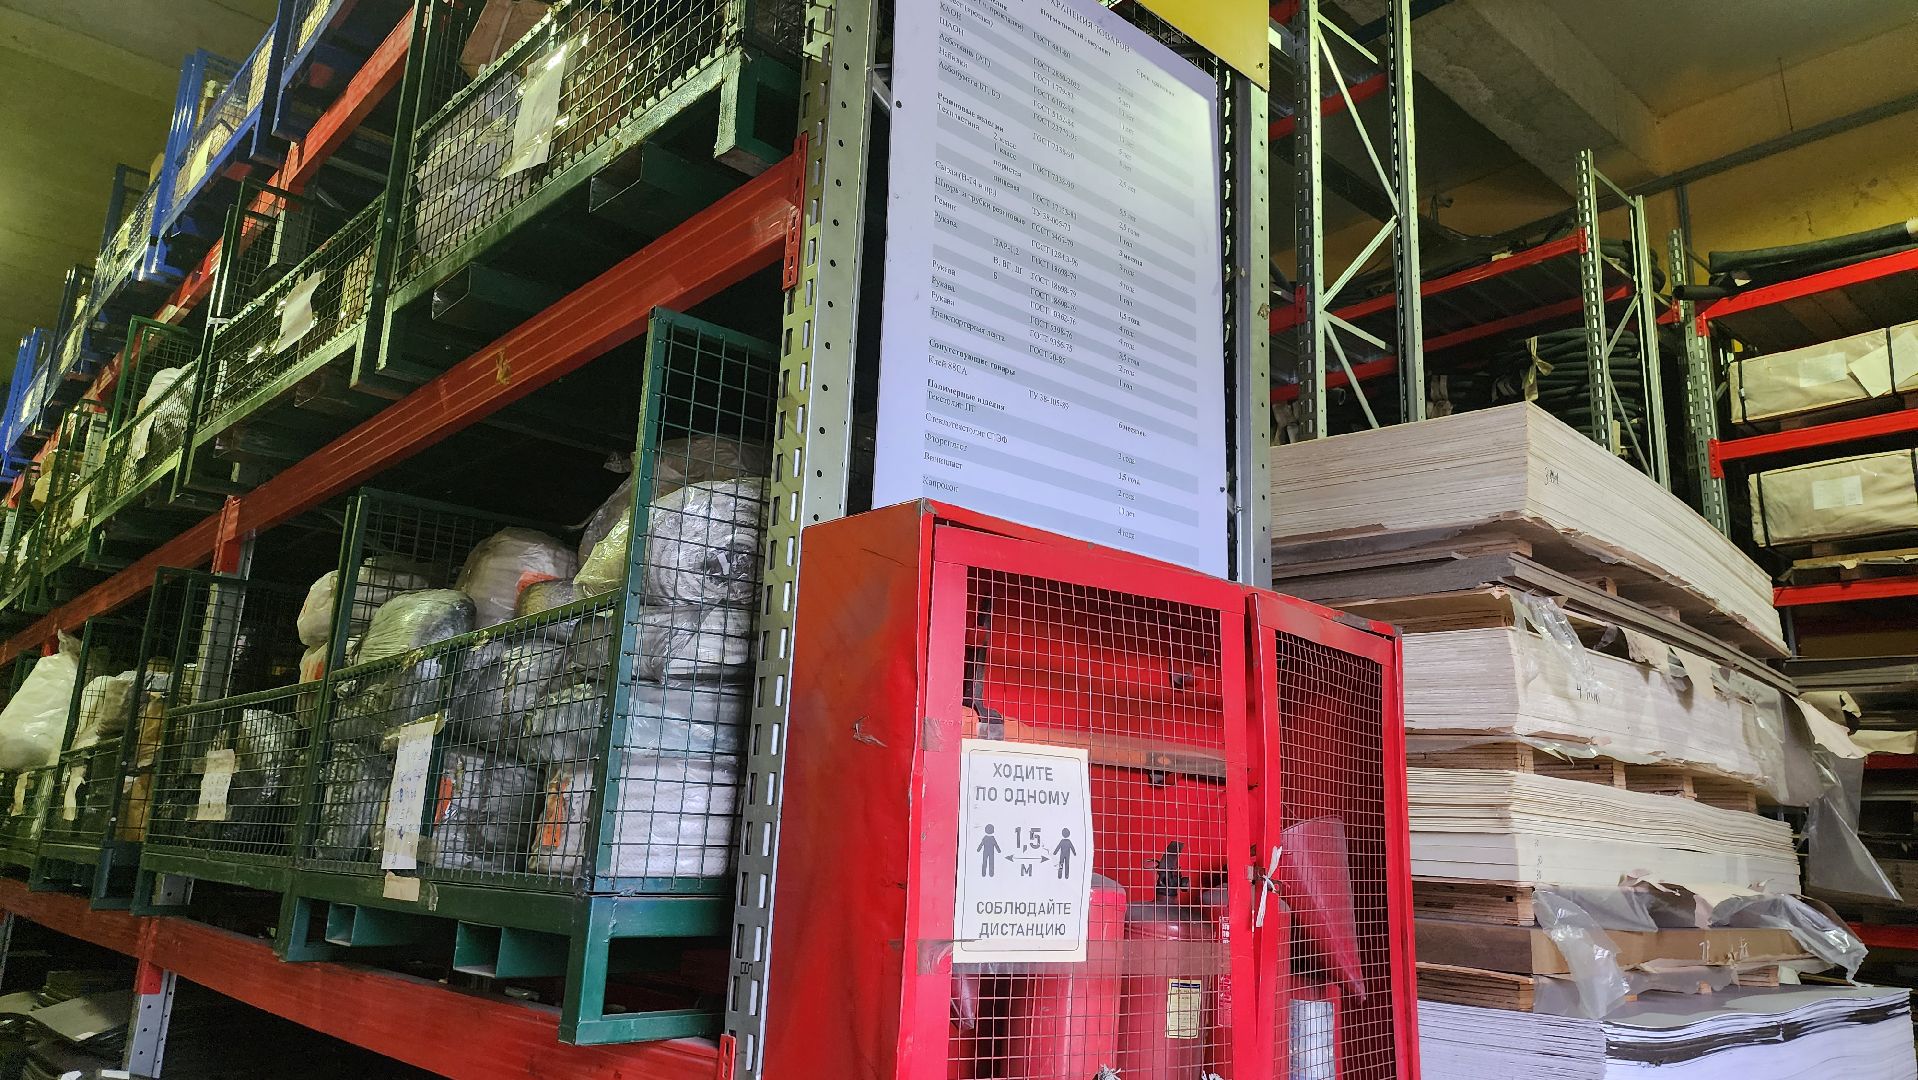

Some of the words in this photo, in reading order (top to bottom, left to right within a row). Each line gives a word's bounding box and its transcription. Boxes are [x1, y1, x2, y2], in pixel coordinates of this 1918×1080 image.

[940, 2, 961, 20] КАОН
[990, 6, 1024, 32] прокладки)
[940, 16, 964, 36] ШАОН
[1040, 8, 1084, 40] Нормативный
[939, 33, 973, 58] Асботкань
[1034, 32, 1050, 46] ГОСТ
[1095, 24, 1130, 52] ТОВАРОВ
[1033, 58, 1050, 72] ГОСТ
[1033, 72, 1050, 86] ГОСТ
[1033, 86, 1050, 100] ГОСТ
[938, 92, 975, 118] Резиновые
[1033, 100, 1050, 114] ГОСТ
[938, 103, 980, 130] Техпластина
[1033, 112, 1050, 127] ГОСТ
[994, 132, 998, 140] 2
[1000, 137, 1016, 150] класс
[1033, 132, 1050, 147] ГОСТ
[1000, 148, 1016, 160] класс
[994, 160, 1021, 178] пористая
[1032, 163, 1050, 178] ГОСТ
[994, 176, 1019, 192] пищевая
[935, 176, 960, 194] Шнуры
[969, 194, 991, 210] трубки
[992, 206, 1025, 226] резиновые
[935, 195, 957, 212] Ремни
[1032, 193, 1050, 206] ГОСТ
[935, 210, 958, 228] Рукава
[1032, 223, 1050, 236] ГОСТ
[1032, 240, 1050, 253] ГОСТ
[932, 260, 956, 276] Рукава
[1032, 256, 1049, 269] ГОСТ
[932, 276, 955, 292] Рукава
[1031, 273, 1049, 286] ГОСТ
[931, 291, 954, 307] Рукава
[1031, 288, 1049, 301] ГОСТ
[1030, 301, 1049, 314] ГОСТ
[1052, 310, 1076, 325] 0362-76
[1030, 316, 1049, 329] ГОСТ
[1030, 330, 1049, 343] ГОСТ
[929, 339, 988, 366] Сопутствующие
[990, 361, 1016, 375] товары
[1029, 344, 1048, 358] ГОСТ
[928, 355, 947, 368] Клей
[927, 390, 964, 409] Текстолит
[965, 403, 976, 412] ПТ
[928, 379, 975, 401] Полимерные
[977, 398, 1005, 411] изделия
[1028, 389, 1038, 400] ТУ
[925, 433, 967, 451] Фторопласт
[924, 452, 962, 470] Винипласт
[922, 475, 959, 492] Капролон
[1576, 682, 1582, 699] 4
[993, 762, 1054, 782] ХОДИТЕ
[976, 786, 998, 801] ПО
[1004, 788, 1070, 806] ОДНОМУ
[1015, 826, 1042, 853] 1,5
[976, 899, 1071, 917] СОБЛЮДАЙТЕ
[978, 923, 1065, 938] ДИСТАНЦИЮ
